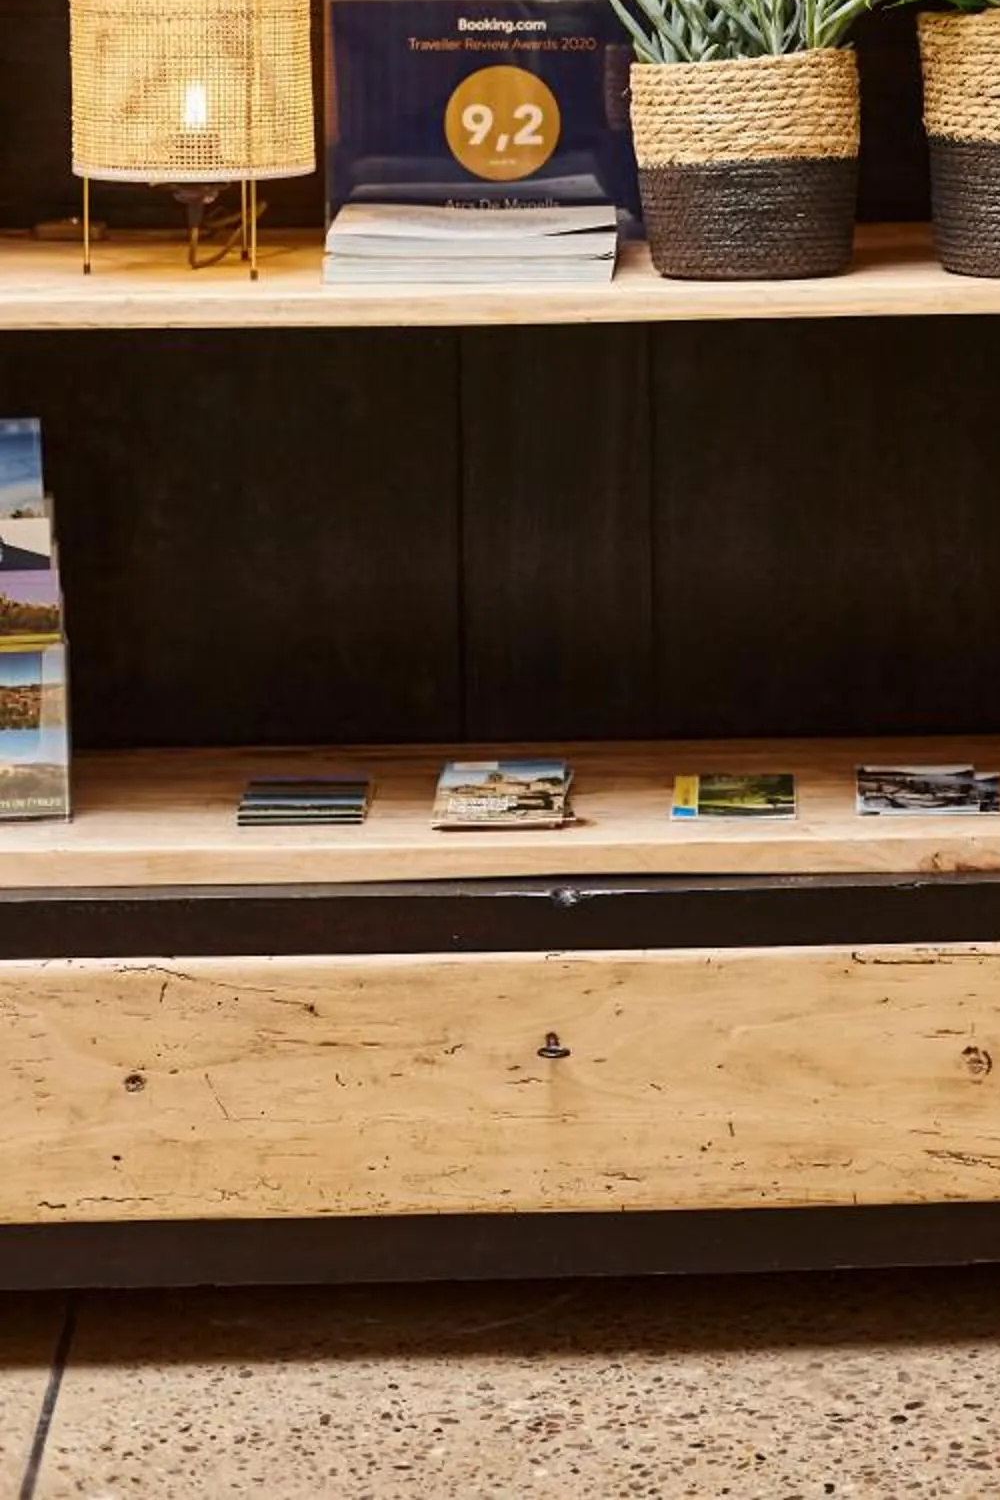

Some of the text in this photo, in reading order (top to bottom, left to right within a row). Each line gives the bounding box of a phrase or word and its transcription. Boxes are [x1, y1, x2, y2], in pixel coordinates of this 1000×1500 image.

[457, 17, 547, 34] Booking.com
[408, 37, 597, 50] Traveller Review Awards 2020
[461, 103, 544, 153] 9,2
